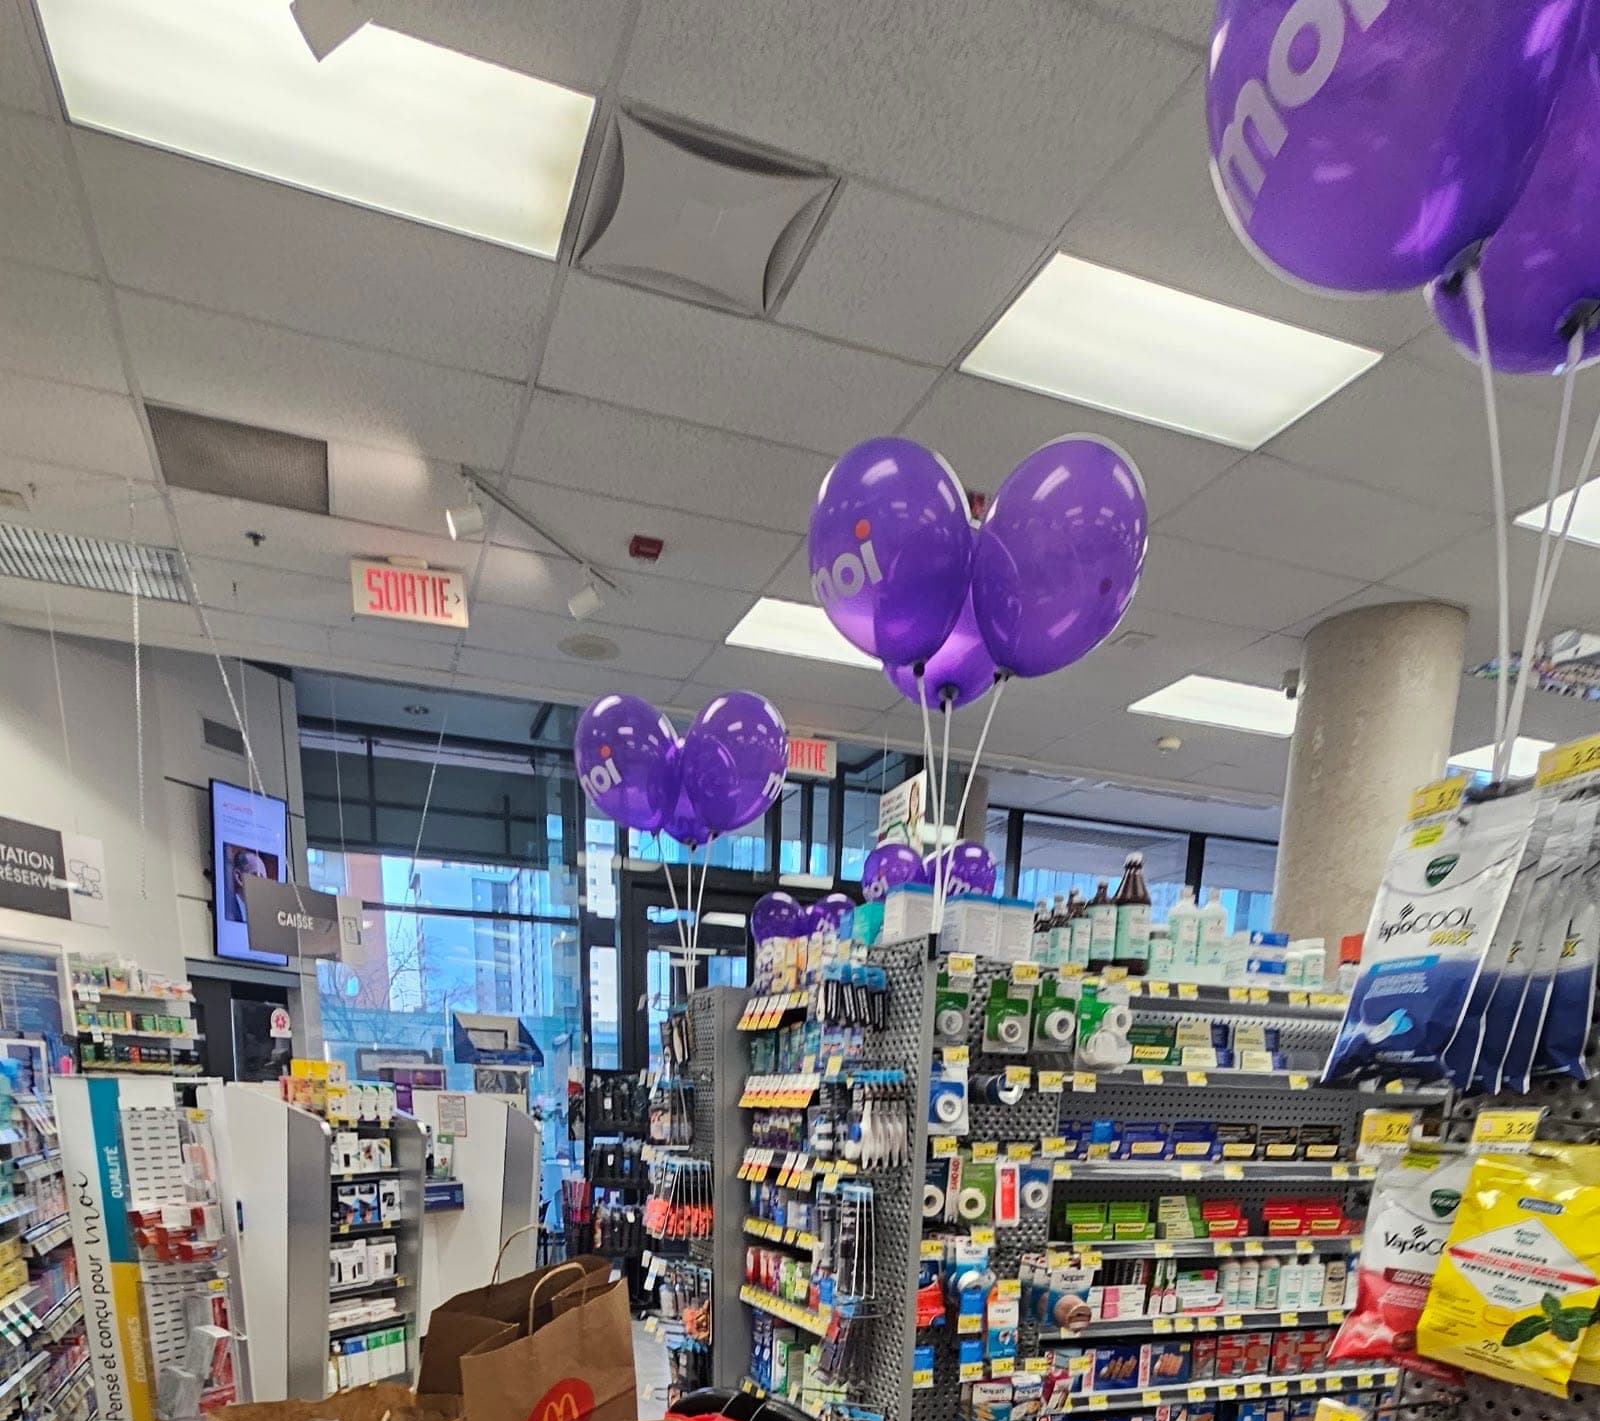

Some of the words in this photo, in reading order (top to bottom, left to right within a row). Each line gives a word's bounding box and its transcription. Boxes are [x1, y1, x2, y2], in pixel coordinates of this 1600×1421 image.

[1219, 0, 1390, 224] mo
[364, 567, 453, 620] SORTIE
[788, 737, 828, 773] RTIE
[277, 910, 314, 932] CAISSE
[104, 1145, 124, 1199] QUALITÉ
[72, 1170, 100, 1245] moi
[93, 1254, 110, 1294] pour
[99, 1307, 114, 1348] conçu
[104, 1351, 116, 1370] et
[106, 1372, 123, 1421] Pensé
